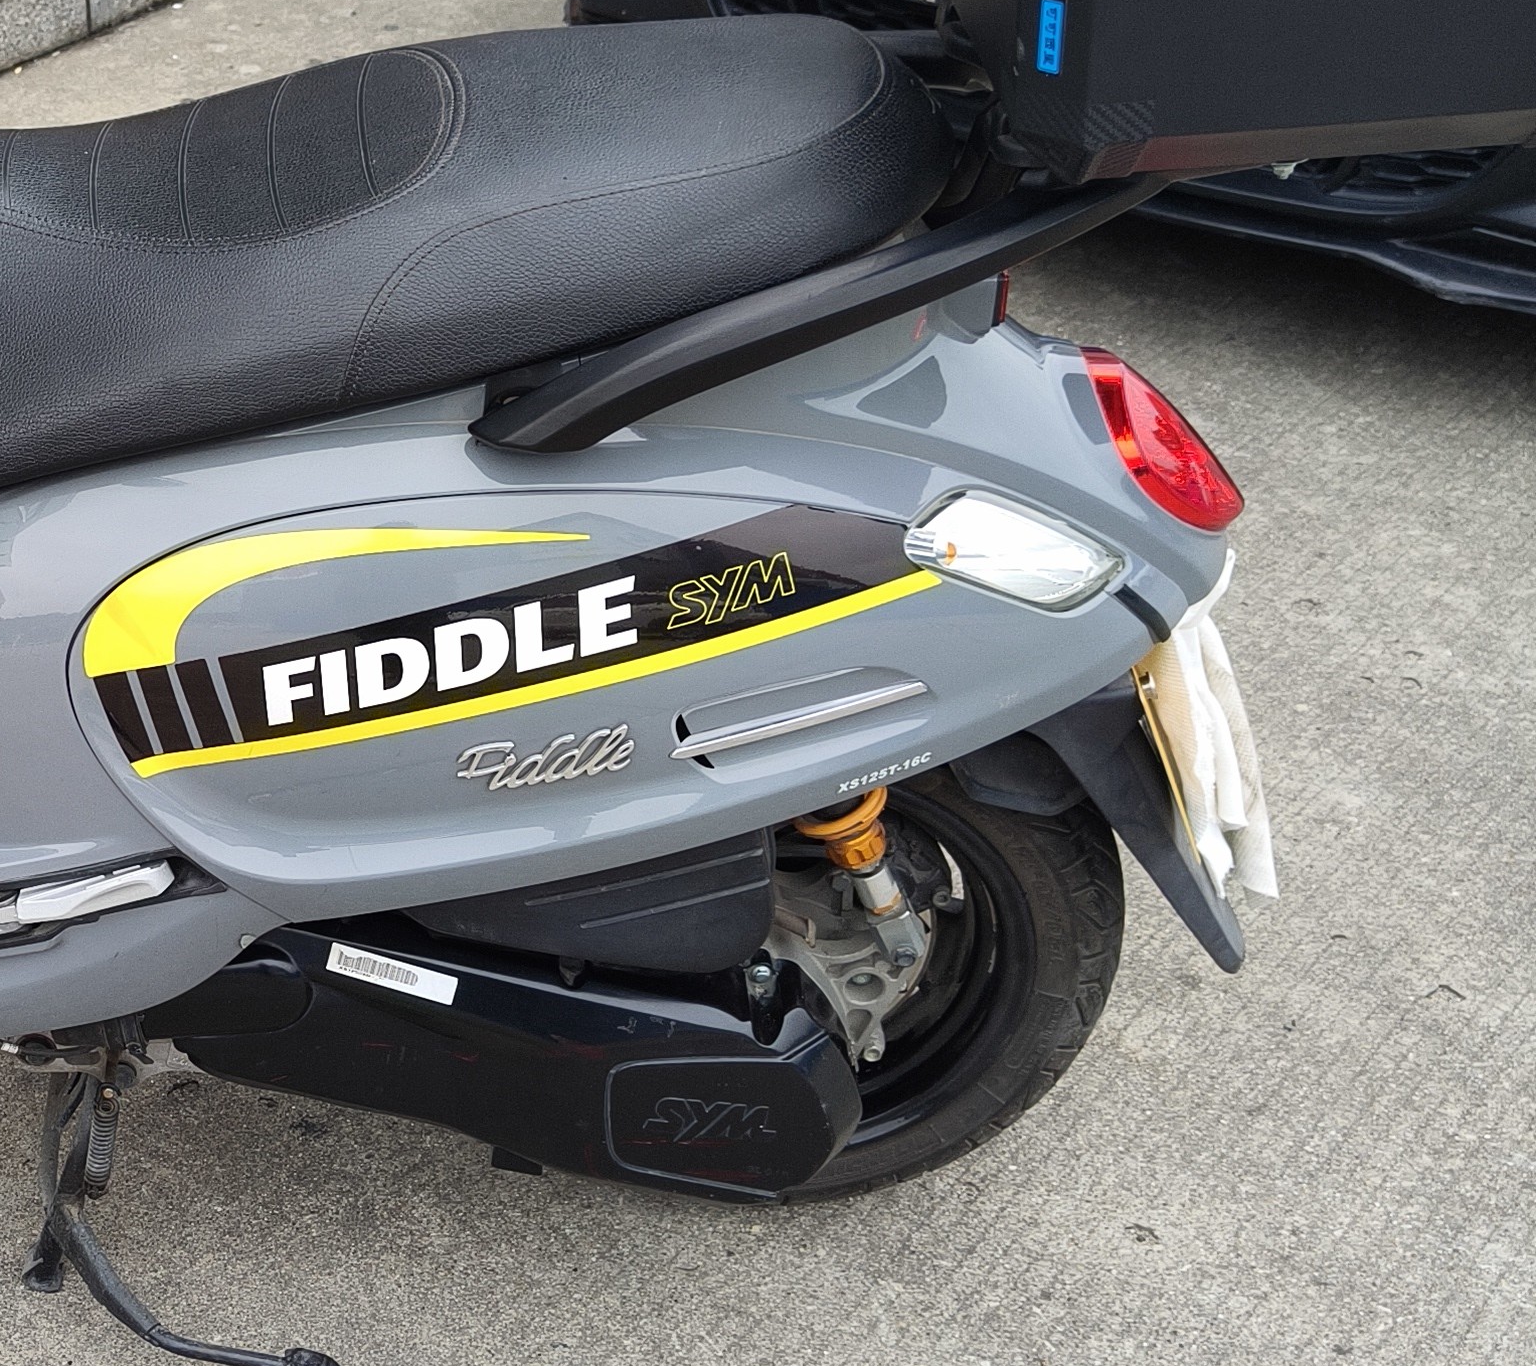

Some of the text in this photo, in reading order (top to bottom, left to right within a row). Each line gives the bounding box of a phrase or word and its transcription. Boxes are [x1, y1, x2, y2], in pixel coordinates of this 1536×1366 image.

[666, 551, 796, 631] SYM
[262, 575, 639, 728] FIDDLE
[457, 723, 635, 791] Fiddle
[837, 752, 932, 794] XS125T-16C
[643, 1096, 777, 1142] SYM
